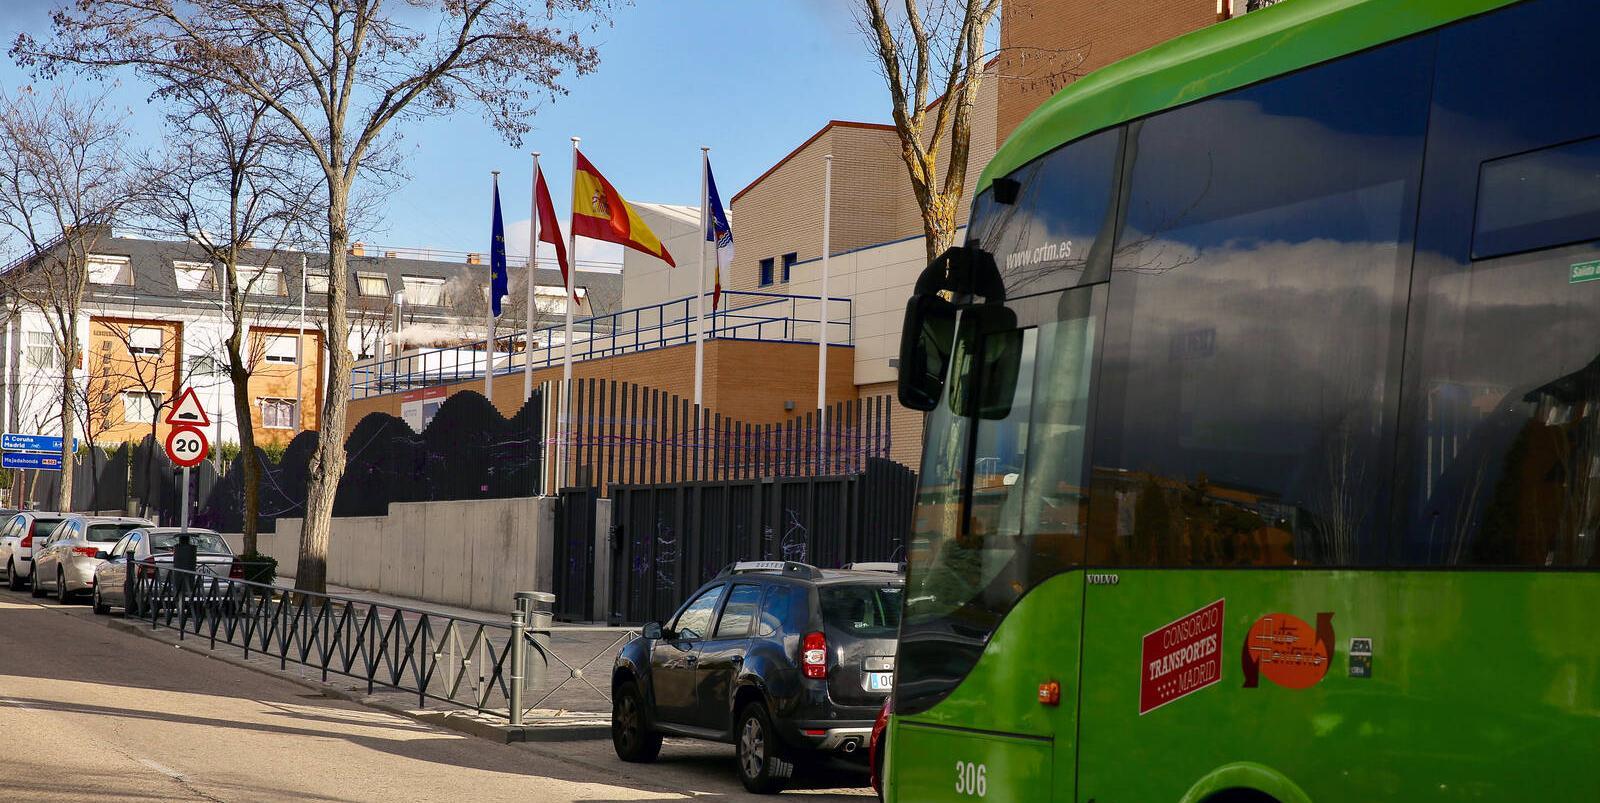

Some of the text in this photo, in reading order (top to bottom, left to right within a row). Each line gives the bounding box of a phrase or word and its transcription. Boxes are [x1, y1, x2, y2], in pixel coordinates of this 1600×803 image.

[1005, 240, 1072, 269] www.crtm.es
[175, 438, 200, 453] 20
[1086, 573, 1119, 585] VOLVO
[1163, 607, 1218, 650] CONSORCIO
[1148, 633, 1217, 681] TRANSPORTES
[1177, 660, 1216, 694] MADRID
[955, 760, 987, 798] 306
